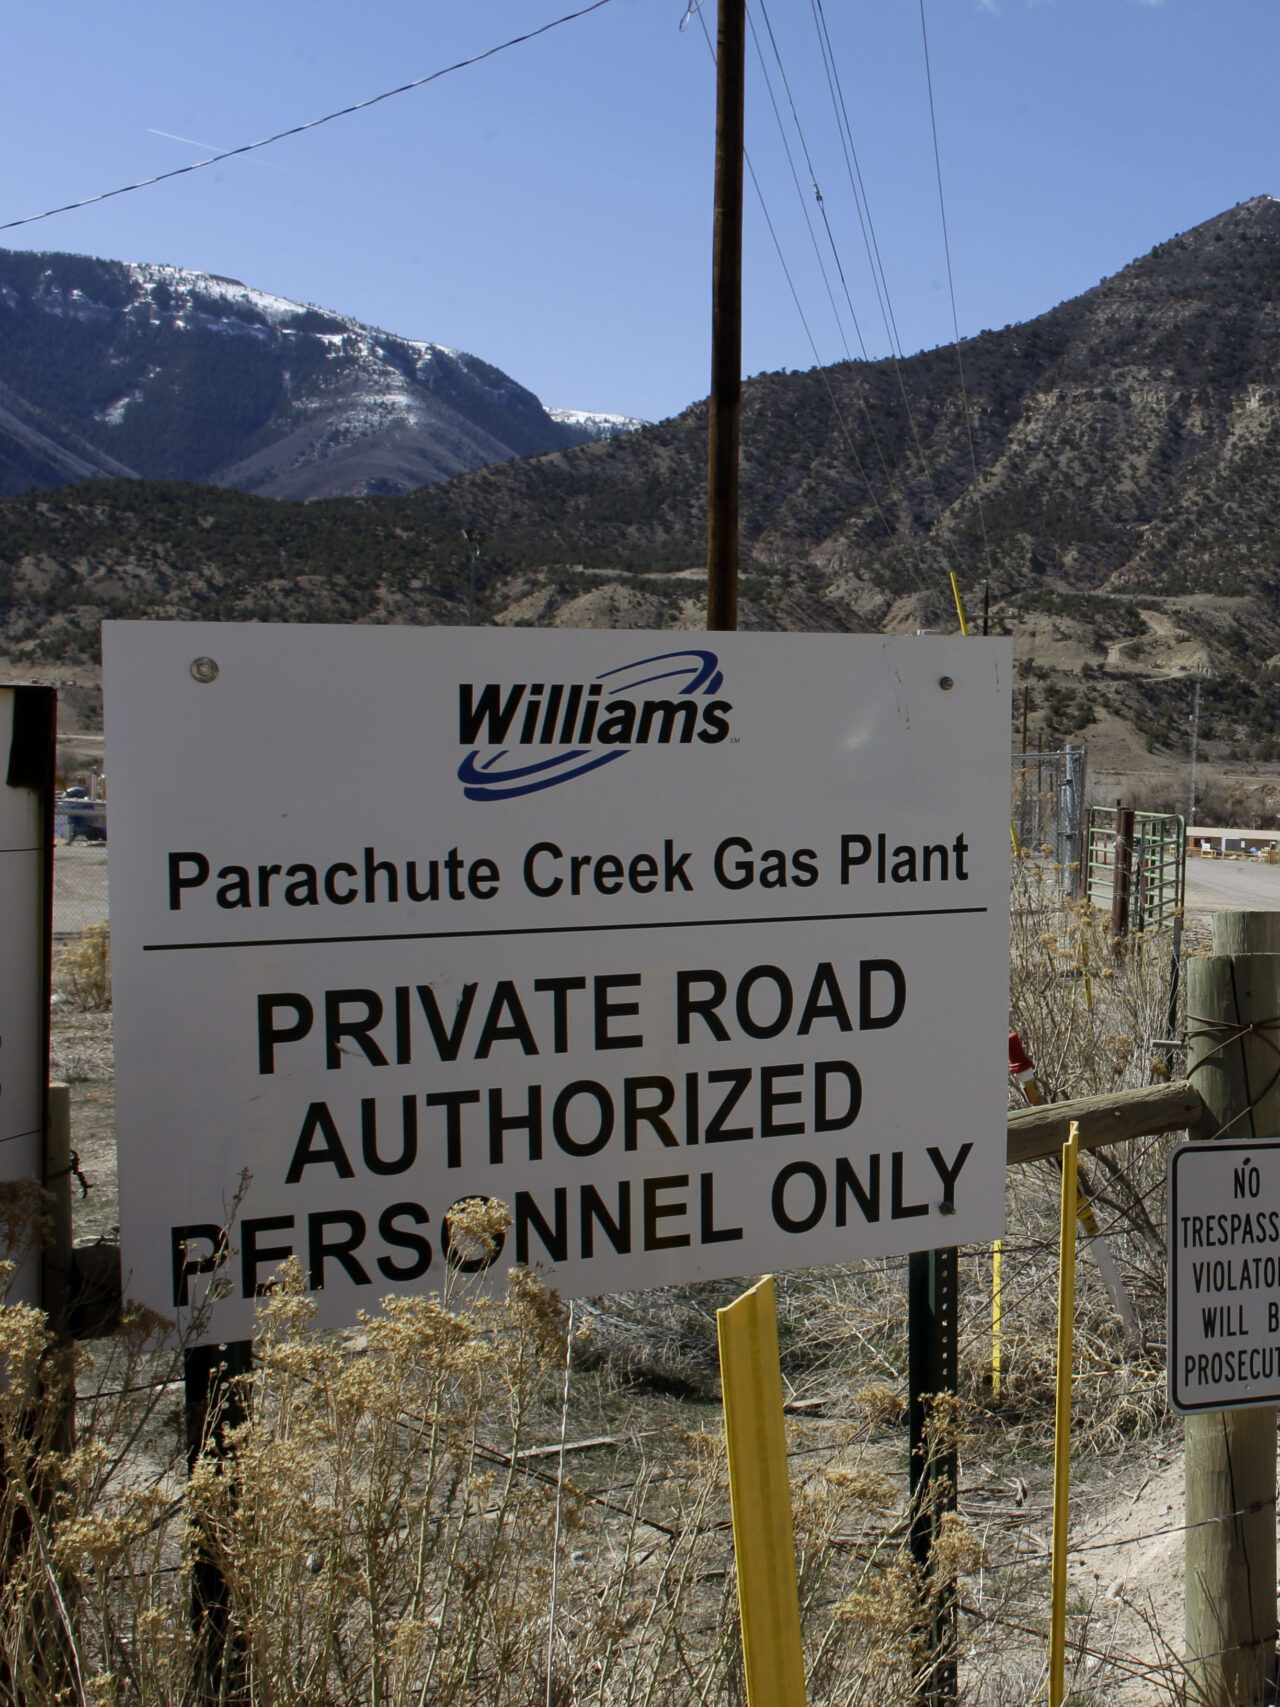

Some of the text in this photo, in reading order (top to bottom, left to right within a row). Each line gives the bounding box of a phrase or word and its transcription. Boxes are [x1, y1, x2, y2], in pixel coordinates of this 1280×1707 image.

[459, 683, 733, 744] Williams
[168, 832, 969, 911] Parachute Creek Gas Plant
[257, 958, 907, 1075] PRIVATE ROAD
[284, 1060, 863, 1184] AUTHORIZED
[1233, 1166, 1260, 1199] NO
[171, 1142, 974, 1307] PERSONNEL ONLY
[1201, 1304, 1249, 1339] WILL
